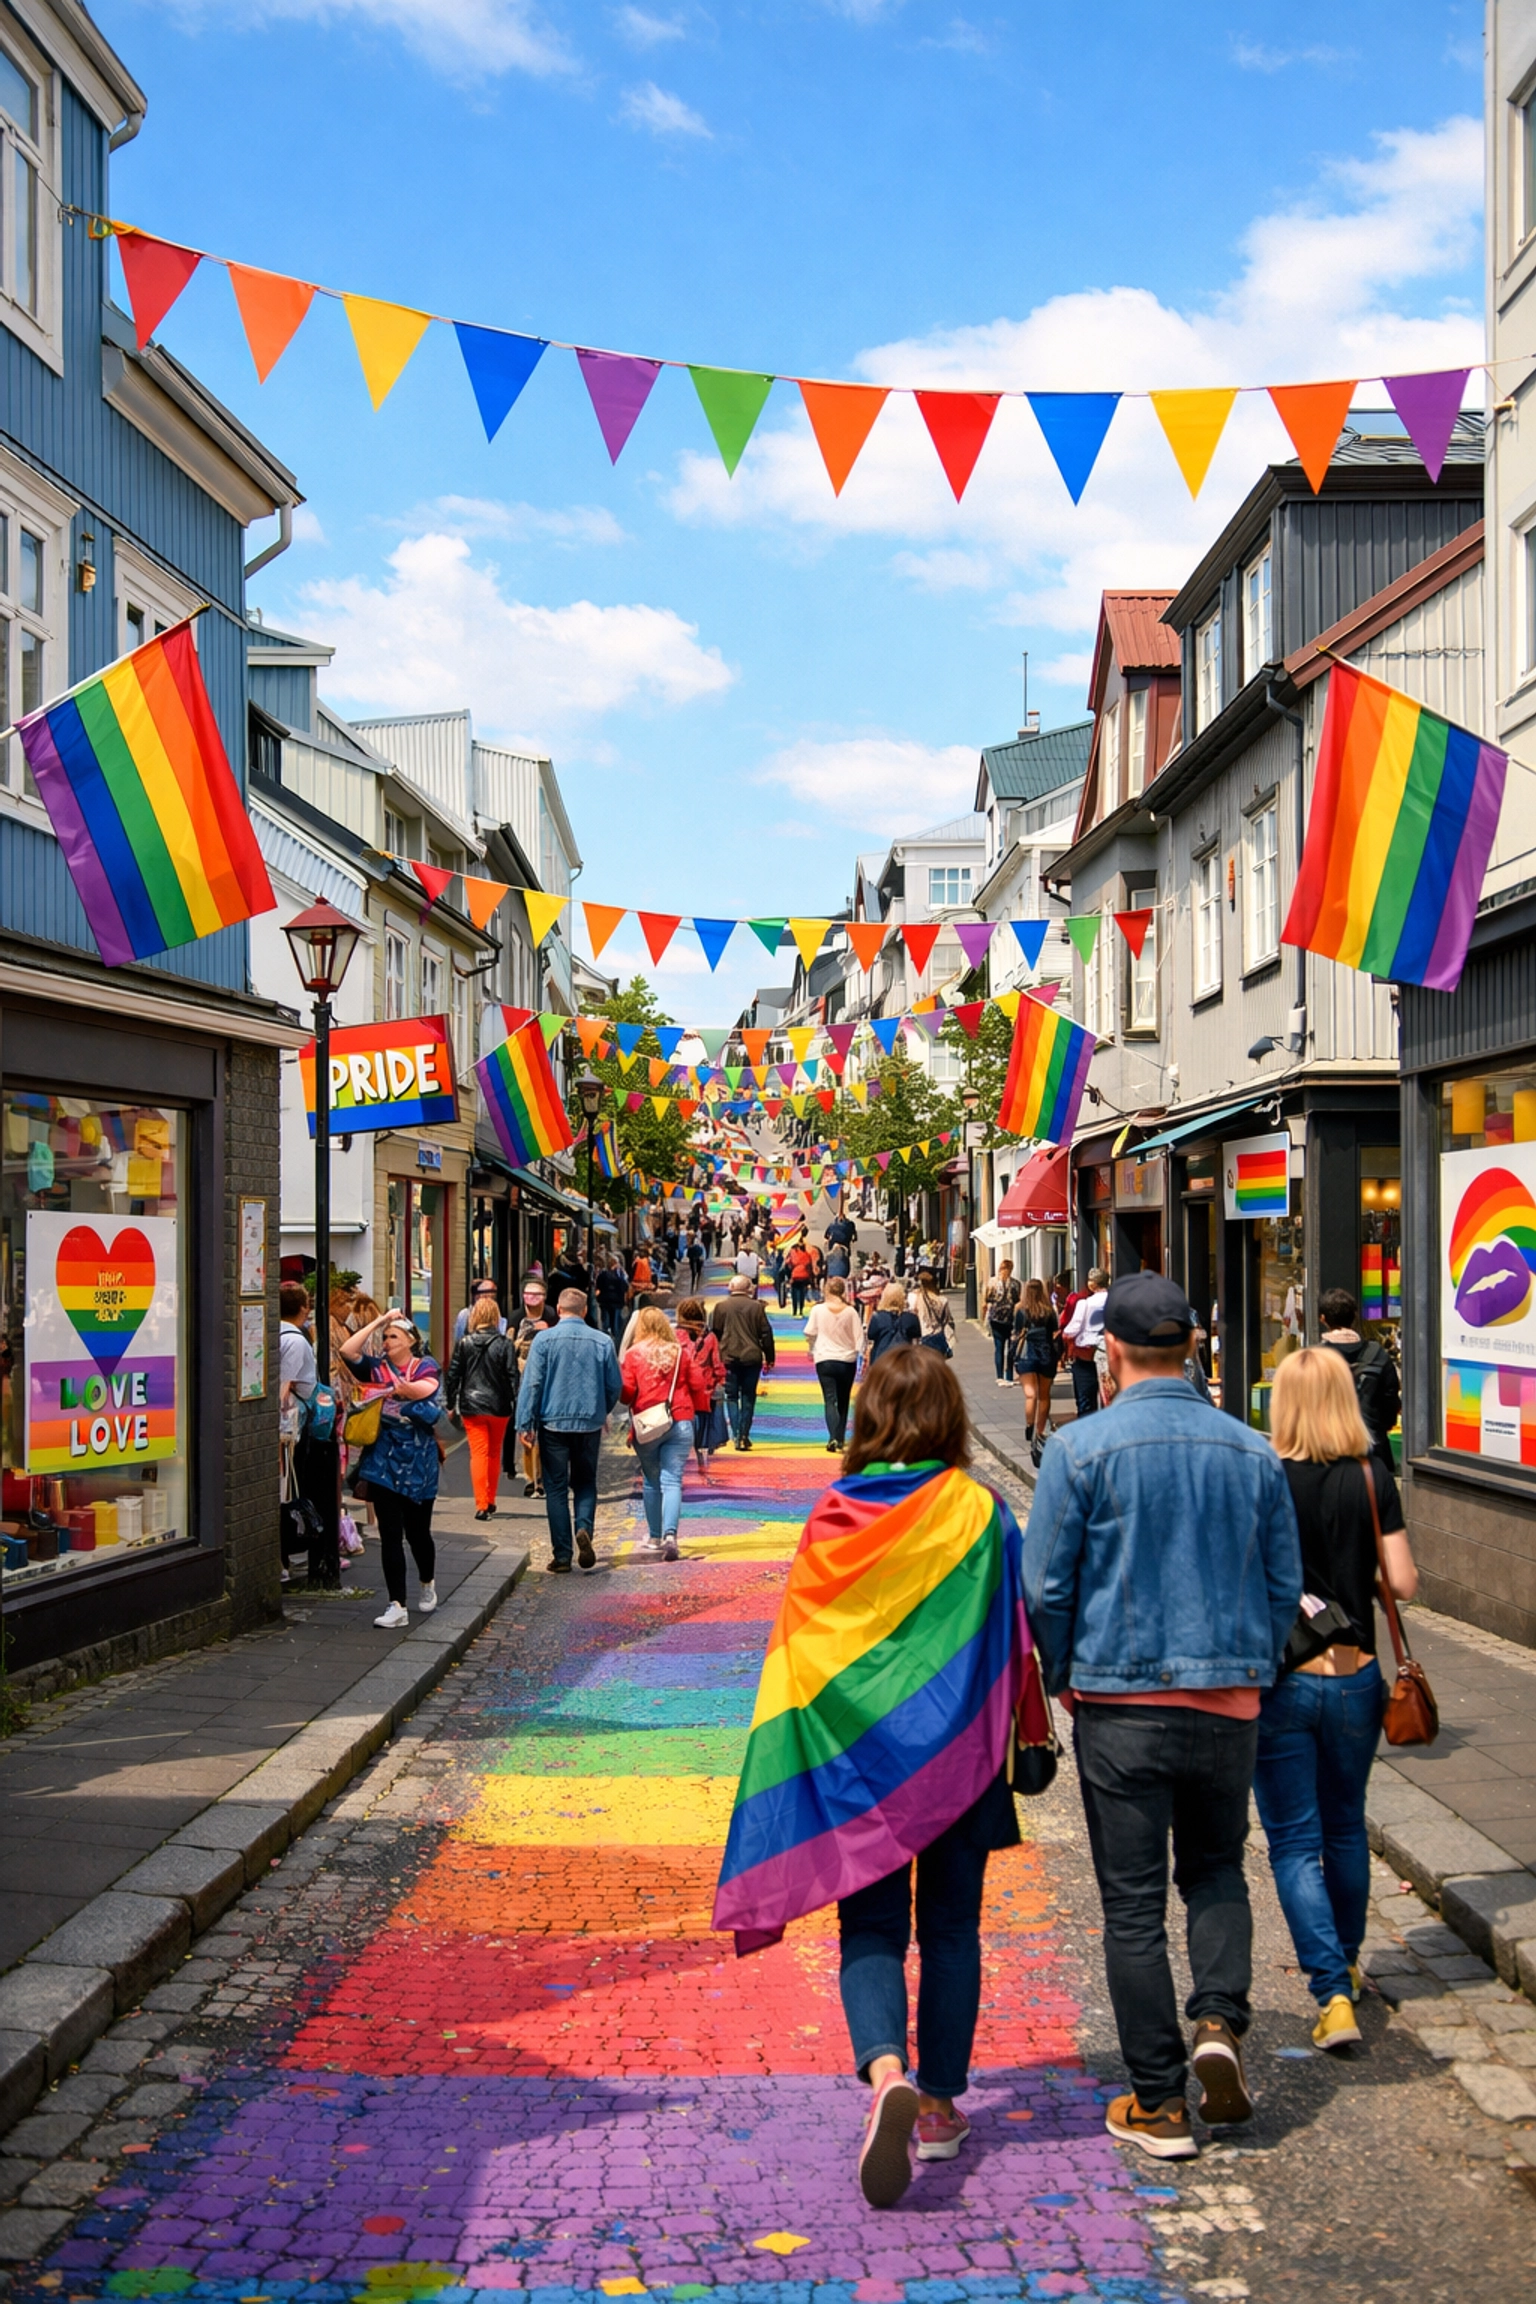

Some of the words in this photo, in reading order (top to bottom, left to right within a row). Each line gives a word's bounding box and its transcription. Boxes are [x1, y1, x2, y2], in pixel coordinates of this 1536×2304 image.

[328, 1043, 441, 1109] PRIDE
[60, 1372, 148, 1412] LOVE
[70, 1414, 148, 1456] LOVE
